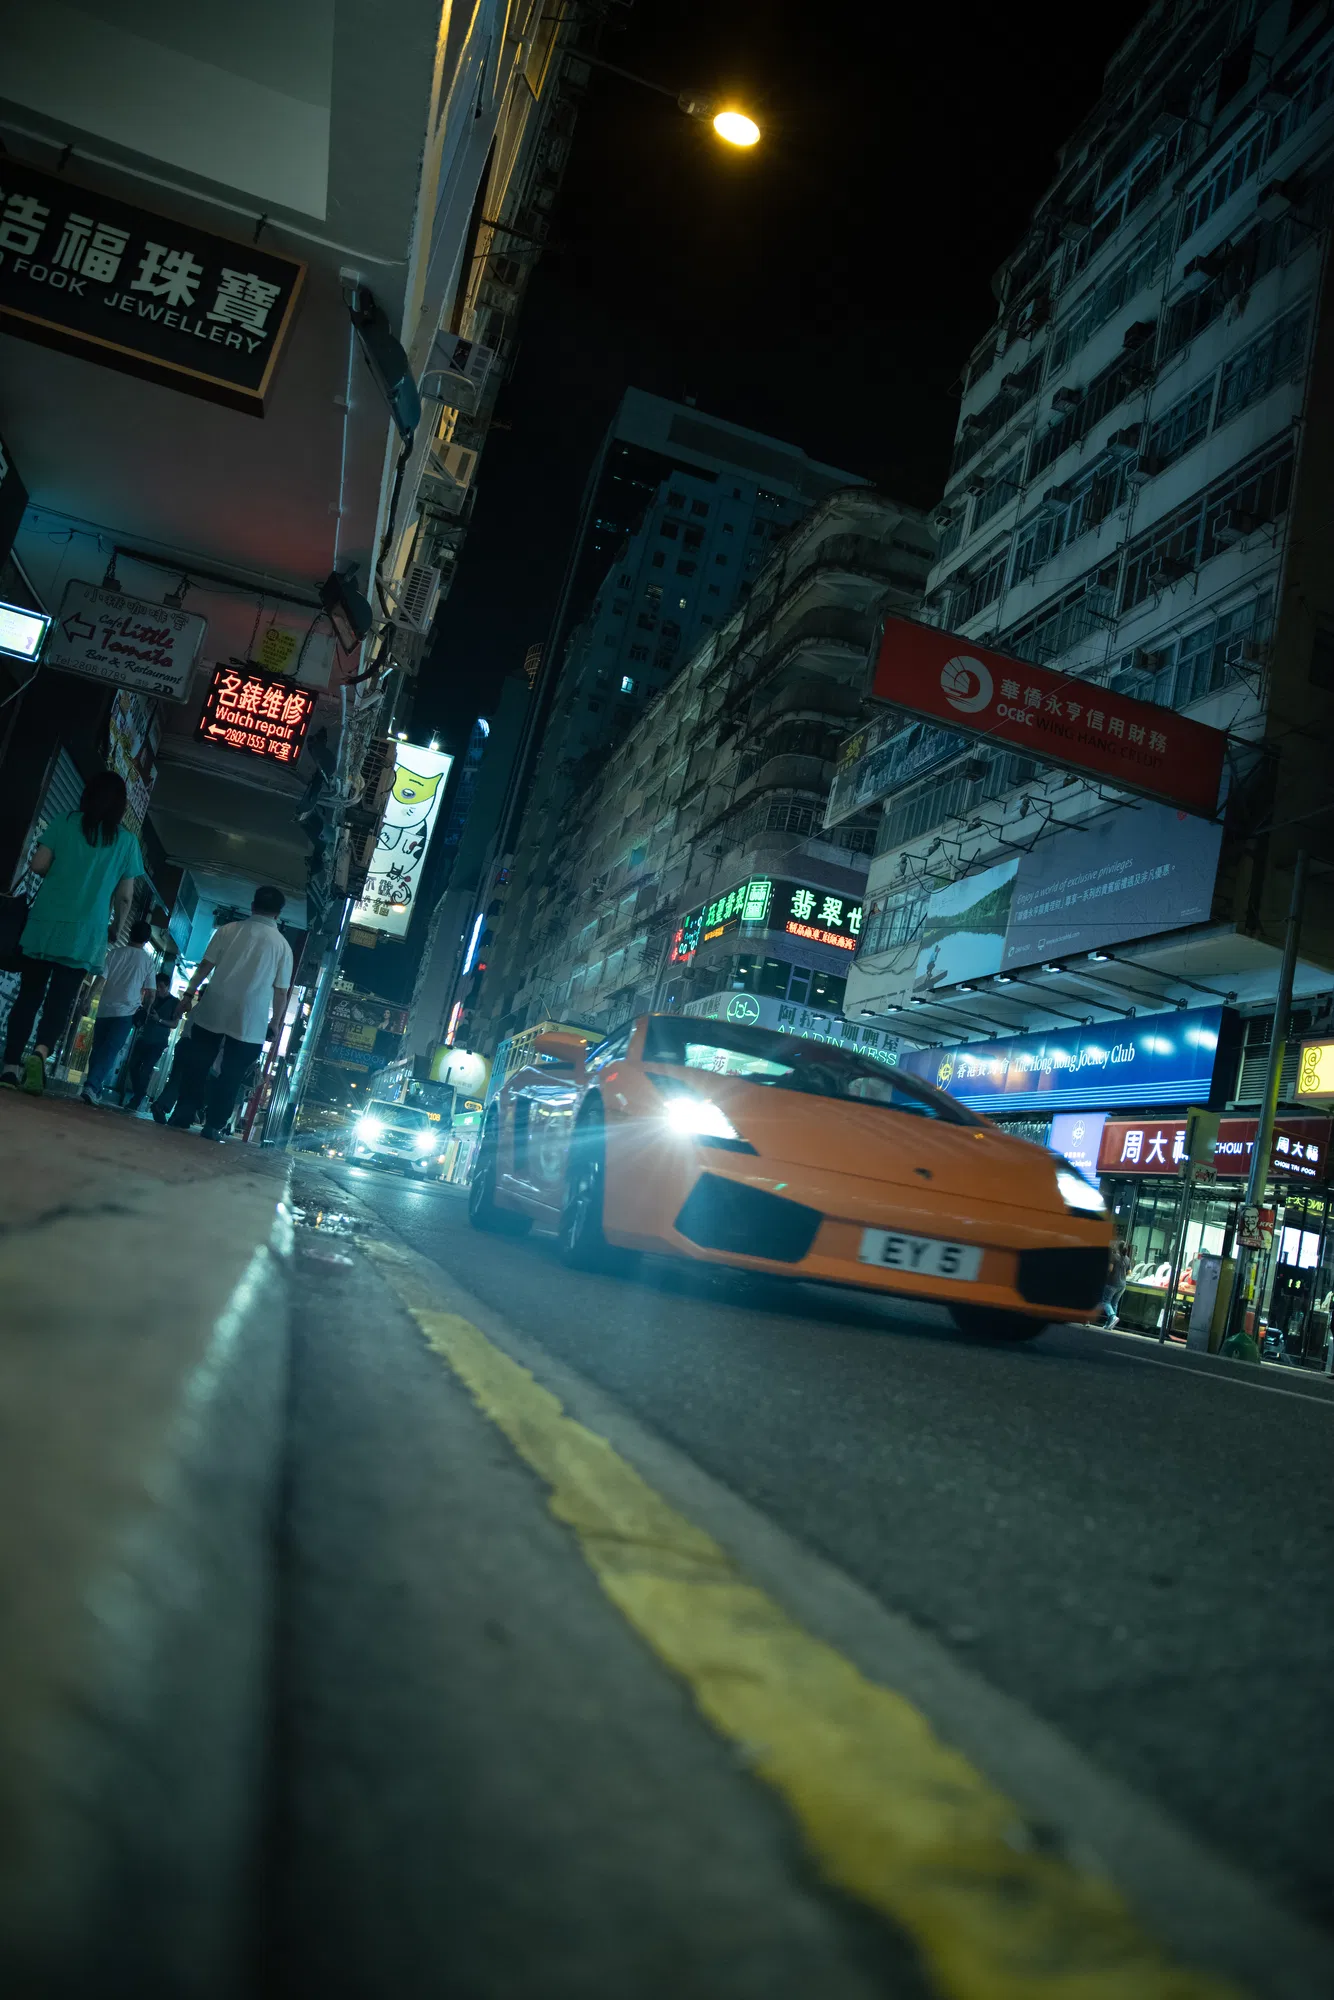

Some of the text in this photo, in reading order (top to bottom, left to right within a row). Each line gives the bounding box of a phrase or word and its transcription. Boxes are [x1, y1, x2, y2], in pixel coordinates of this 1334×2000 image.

[12, 257, 263, 354] FOOK JEWELLERY
[101, 628, 174, 668] Tomato
[120, 617, 175, 649] Little
[85, 649, 108, 663] Bar
[108, 657, 120, 668] &
[124, 660, 184, 685] Restaurant
[214, 704, 295, 740] Watch repair
[996, 703, 1035, 727] OCBC
[1036, 716, 1073, 741] WING
[1077, 732, 1117, 754] HANG
[1000, 678, 1169, 754] 華僑永亨信用財務
[224, 728, 246, 746] 2802
[1040, 880, 1060, 896] world
[1059, 877, 1068, 893] of
[1067, 867, 1098, 888] exclusive
[1097, 857, 1134, 880] privileges
[852, 1042, 897, 1066] MESS
[1030, 1054, 1053, 1075] Hong
[1076, 1046, 1110, 1072] Jockey
[1111, 1042, 1136, 1064] Club
[1276, 1136, 1319, 1162] 周大福
[1274, 1159, 1291, 1169] CHOW
[1300, 1167, 1317, 1176] FOOK
[1259, 1220, 1274, 1229] KFC
[881, 1235, 930, 1268] EY
